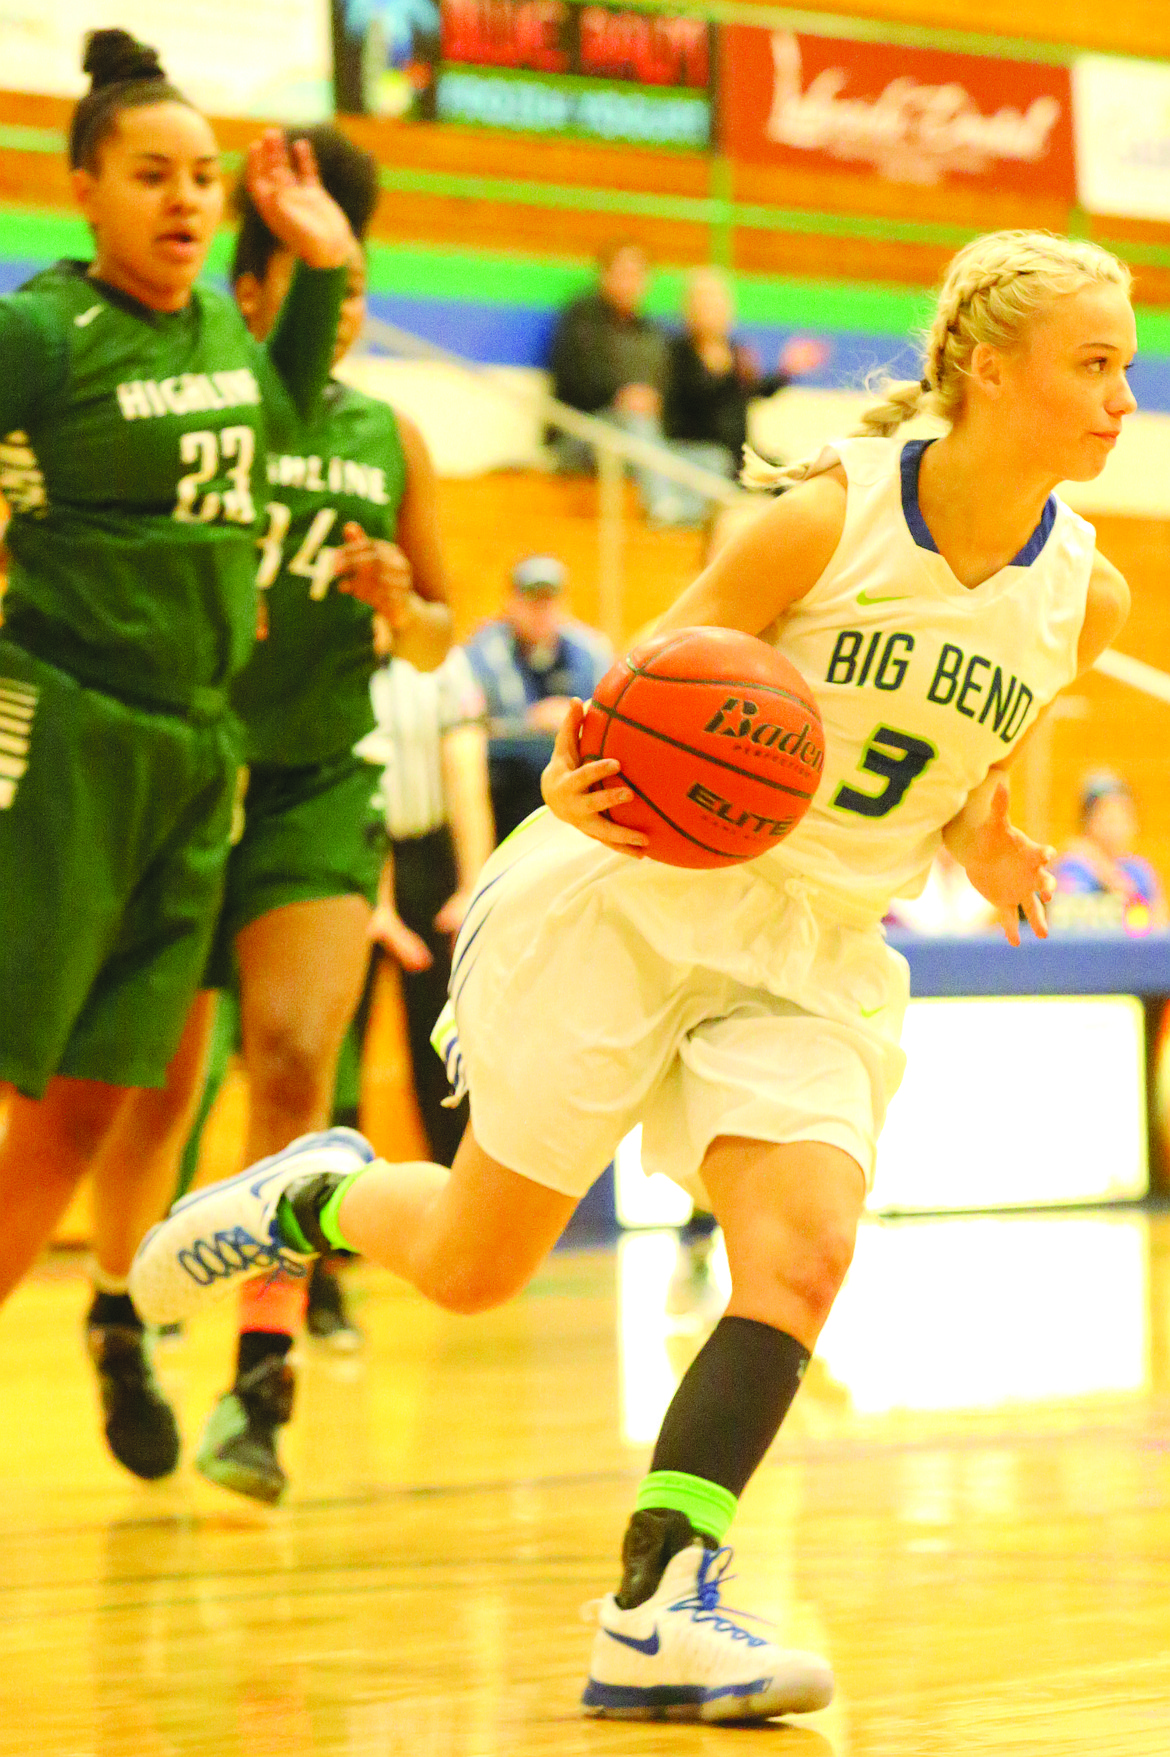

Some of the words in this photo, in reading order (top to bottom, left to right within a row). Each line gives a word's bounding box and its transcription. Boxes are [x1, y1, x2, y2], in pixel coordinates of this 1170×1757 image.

[173, 425, 256, 524] 23
[703, 697, 824, 774] Baden
[825, 630, 915, 691] BIG
[926, 642, 1034, 743] BEND
[829, 721, 939, 819] 3
